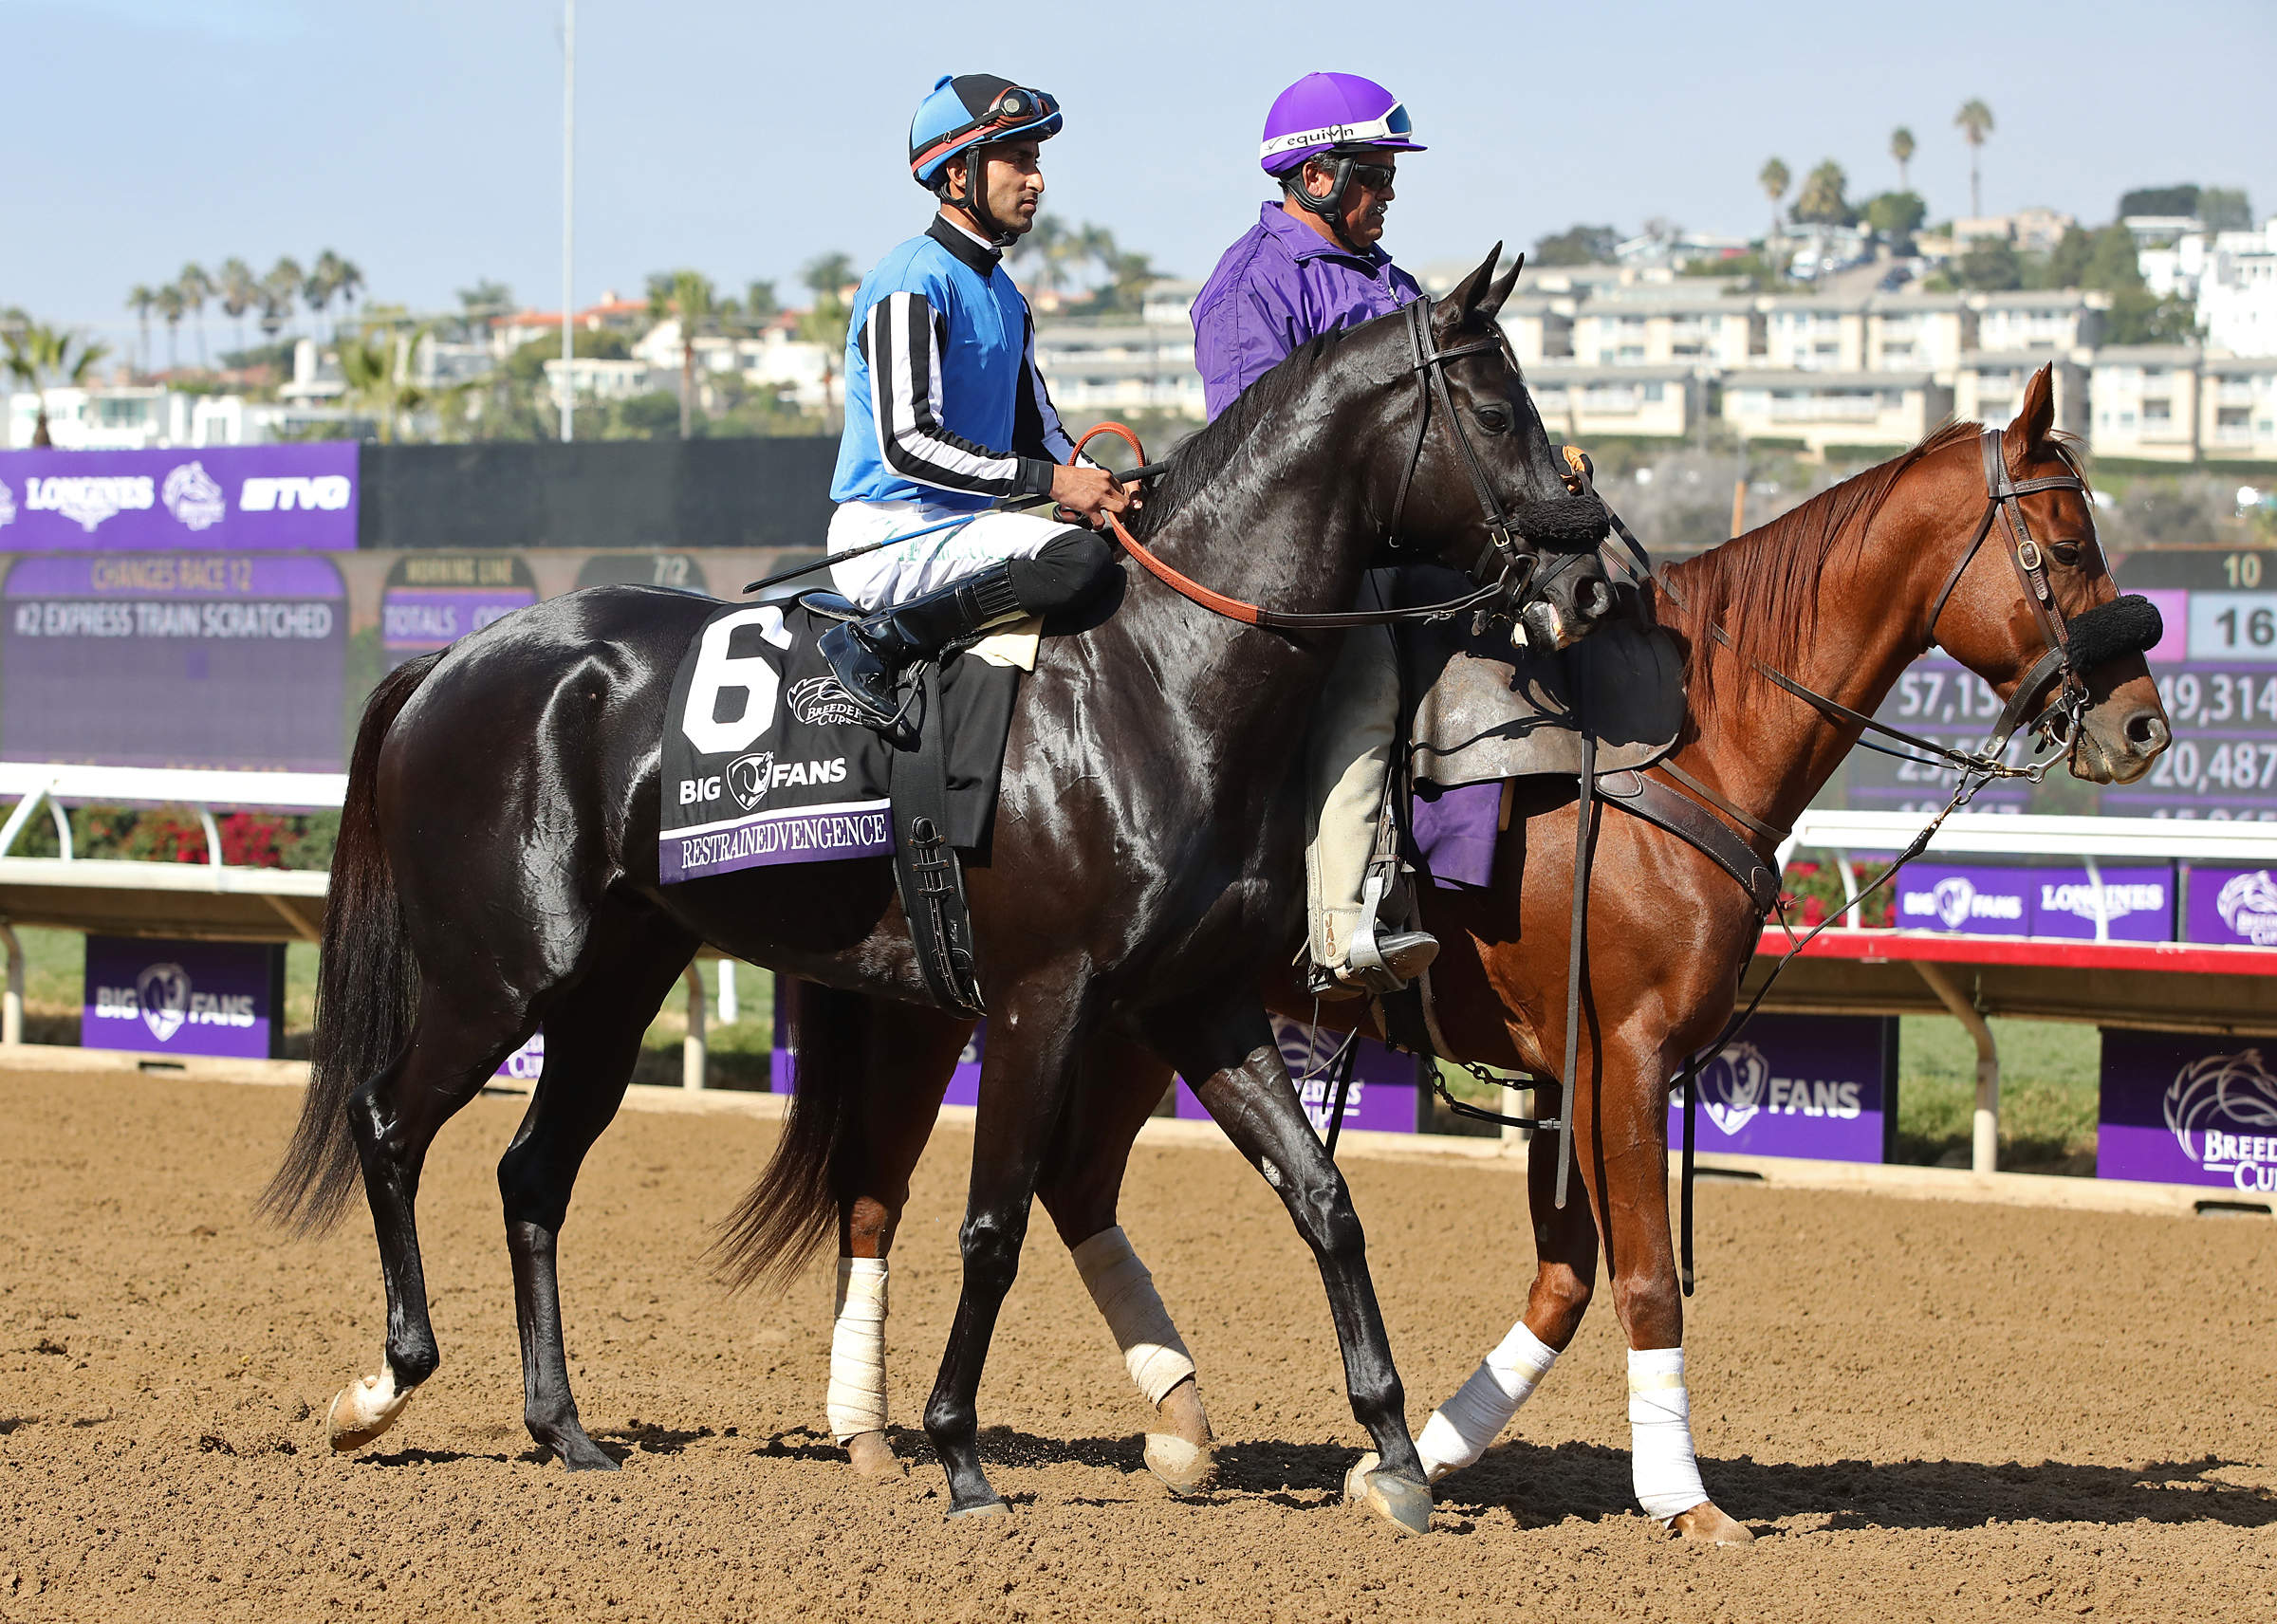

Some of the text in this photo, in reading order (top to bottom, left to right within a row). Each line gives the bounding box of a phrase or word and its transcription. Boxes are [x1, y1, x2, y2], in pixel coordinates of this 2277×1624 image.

[2223, 552, 2263, 588] 10
[44, 602, 134, 637] EXPRESS
[137, 602, 200, 637] TRAIN
[202, 602, 332, 638] SCRATCHED
[383, 605, 457, 637] TOTALS
[682, 605, 793, 754] 6
[679, 757, 847, 805] BIG FANS
[2150, 741, 2277, 795] 20,487
[681, 813, 887, 869] RESTRAINEDVENGENCE
[2041, 883, 2164, 912] LONINES
[96, 987, 255, 1027] BIG FANS
[1768, 1077, 1861, 1119] FANS
